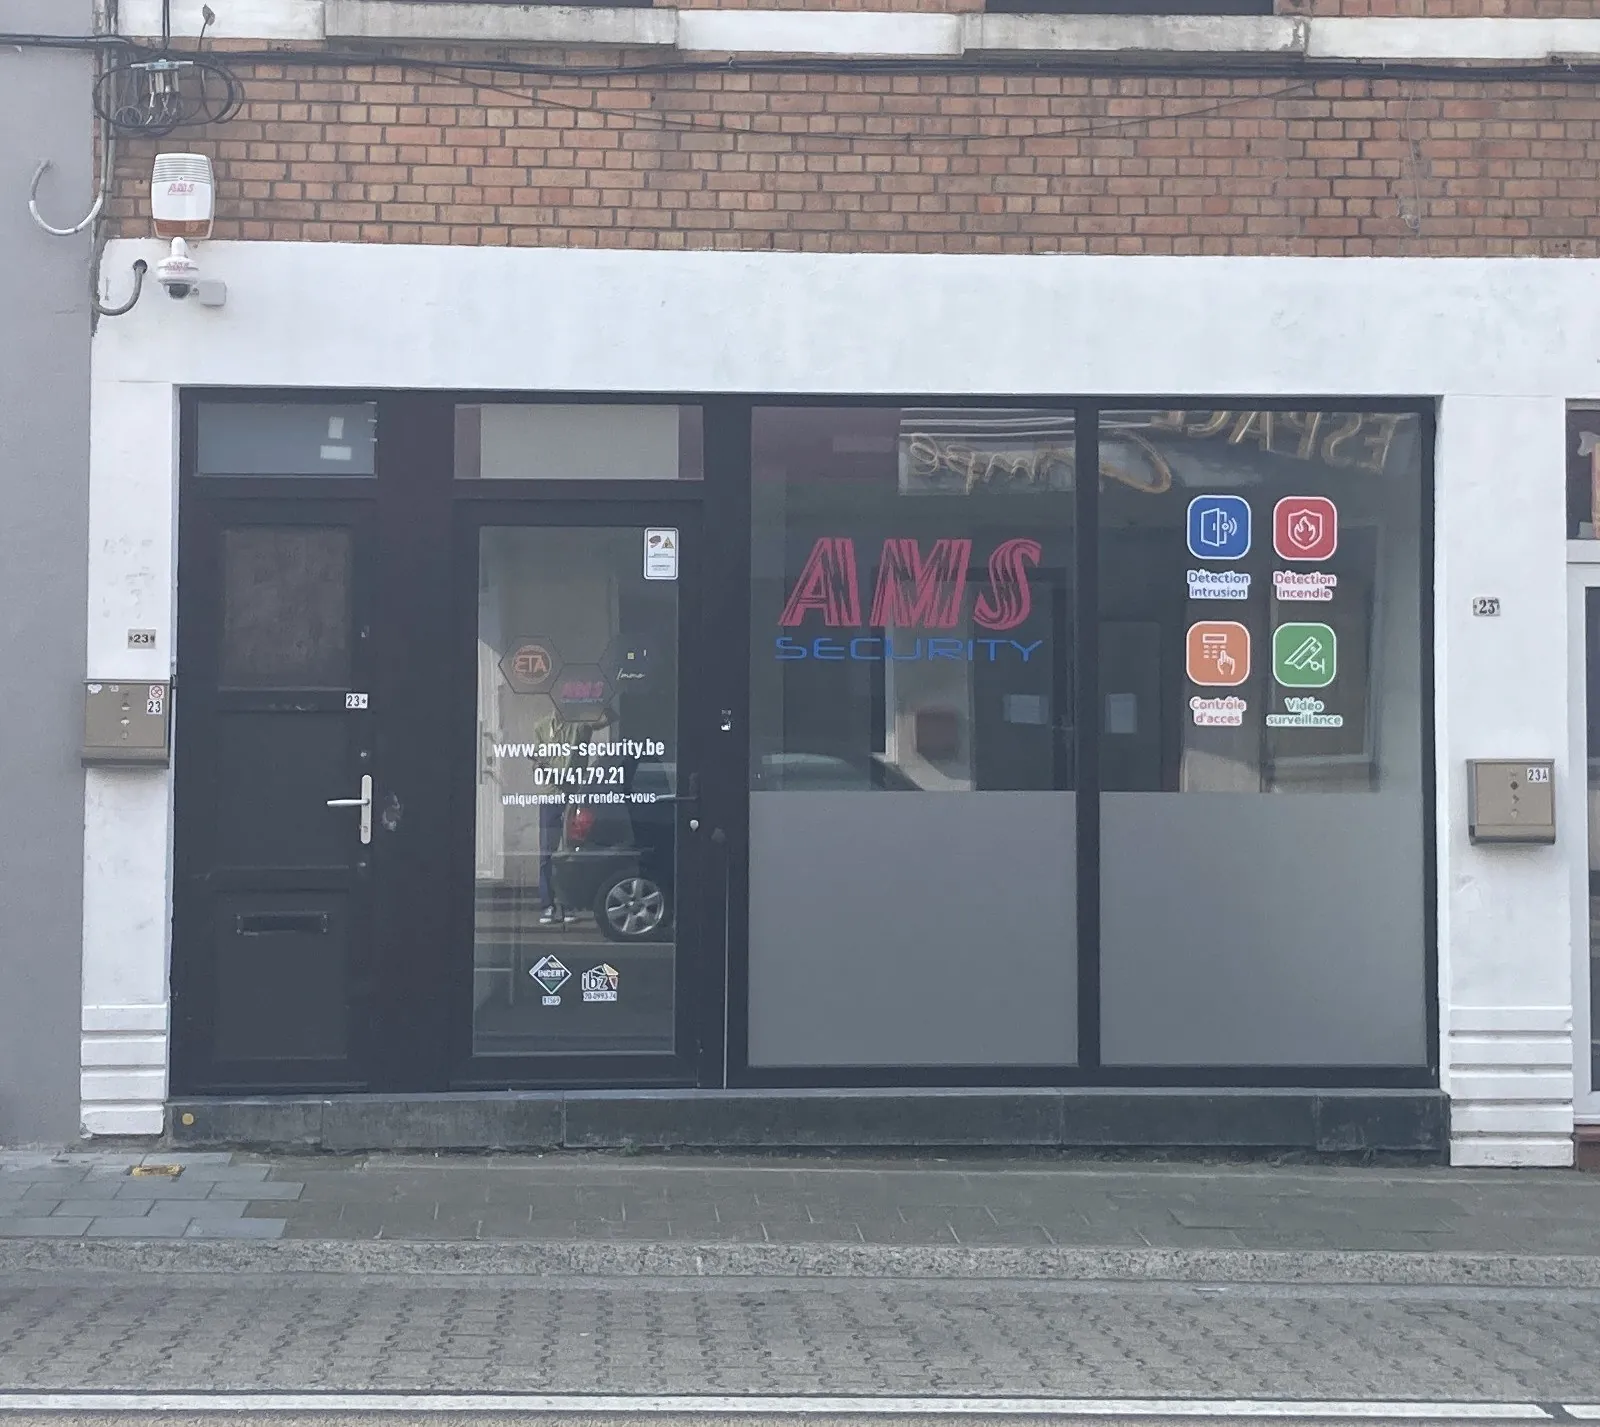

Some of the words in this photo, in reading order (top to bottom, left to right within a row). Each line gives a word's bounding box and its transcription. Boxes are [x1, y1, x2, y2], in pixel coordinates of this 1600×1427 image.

[778, 537, 1042, 630] AMS
[1188, 571, 1250, 584] Détection
[1274, 572, 1336, 585] Détection
[1190, 587, 1247, 598] intrusion
[1278, 587, 1332, 599] incendie
[775, 636, 1043, 662] SECURITY
[147, 701, 161, 713] 23
[1191, 697, 1246, 710] Contrôle
[1285, 698, 1324, 711] Vidéo
[1267, 713, 1342, 725] surveillance
[492, 738, 666, 760] www.ams-security.be
[533, 766, 625, 786] 071/41.79.21
[1528, 768, 1548, 782] 23A
[501, 792, 566, 808] uniquement
[568, 794, 586, 804] sur
[588, 791, 657, 804] rendez-vous
[582, 971, 609, 991] ibz
